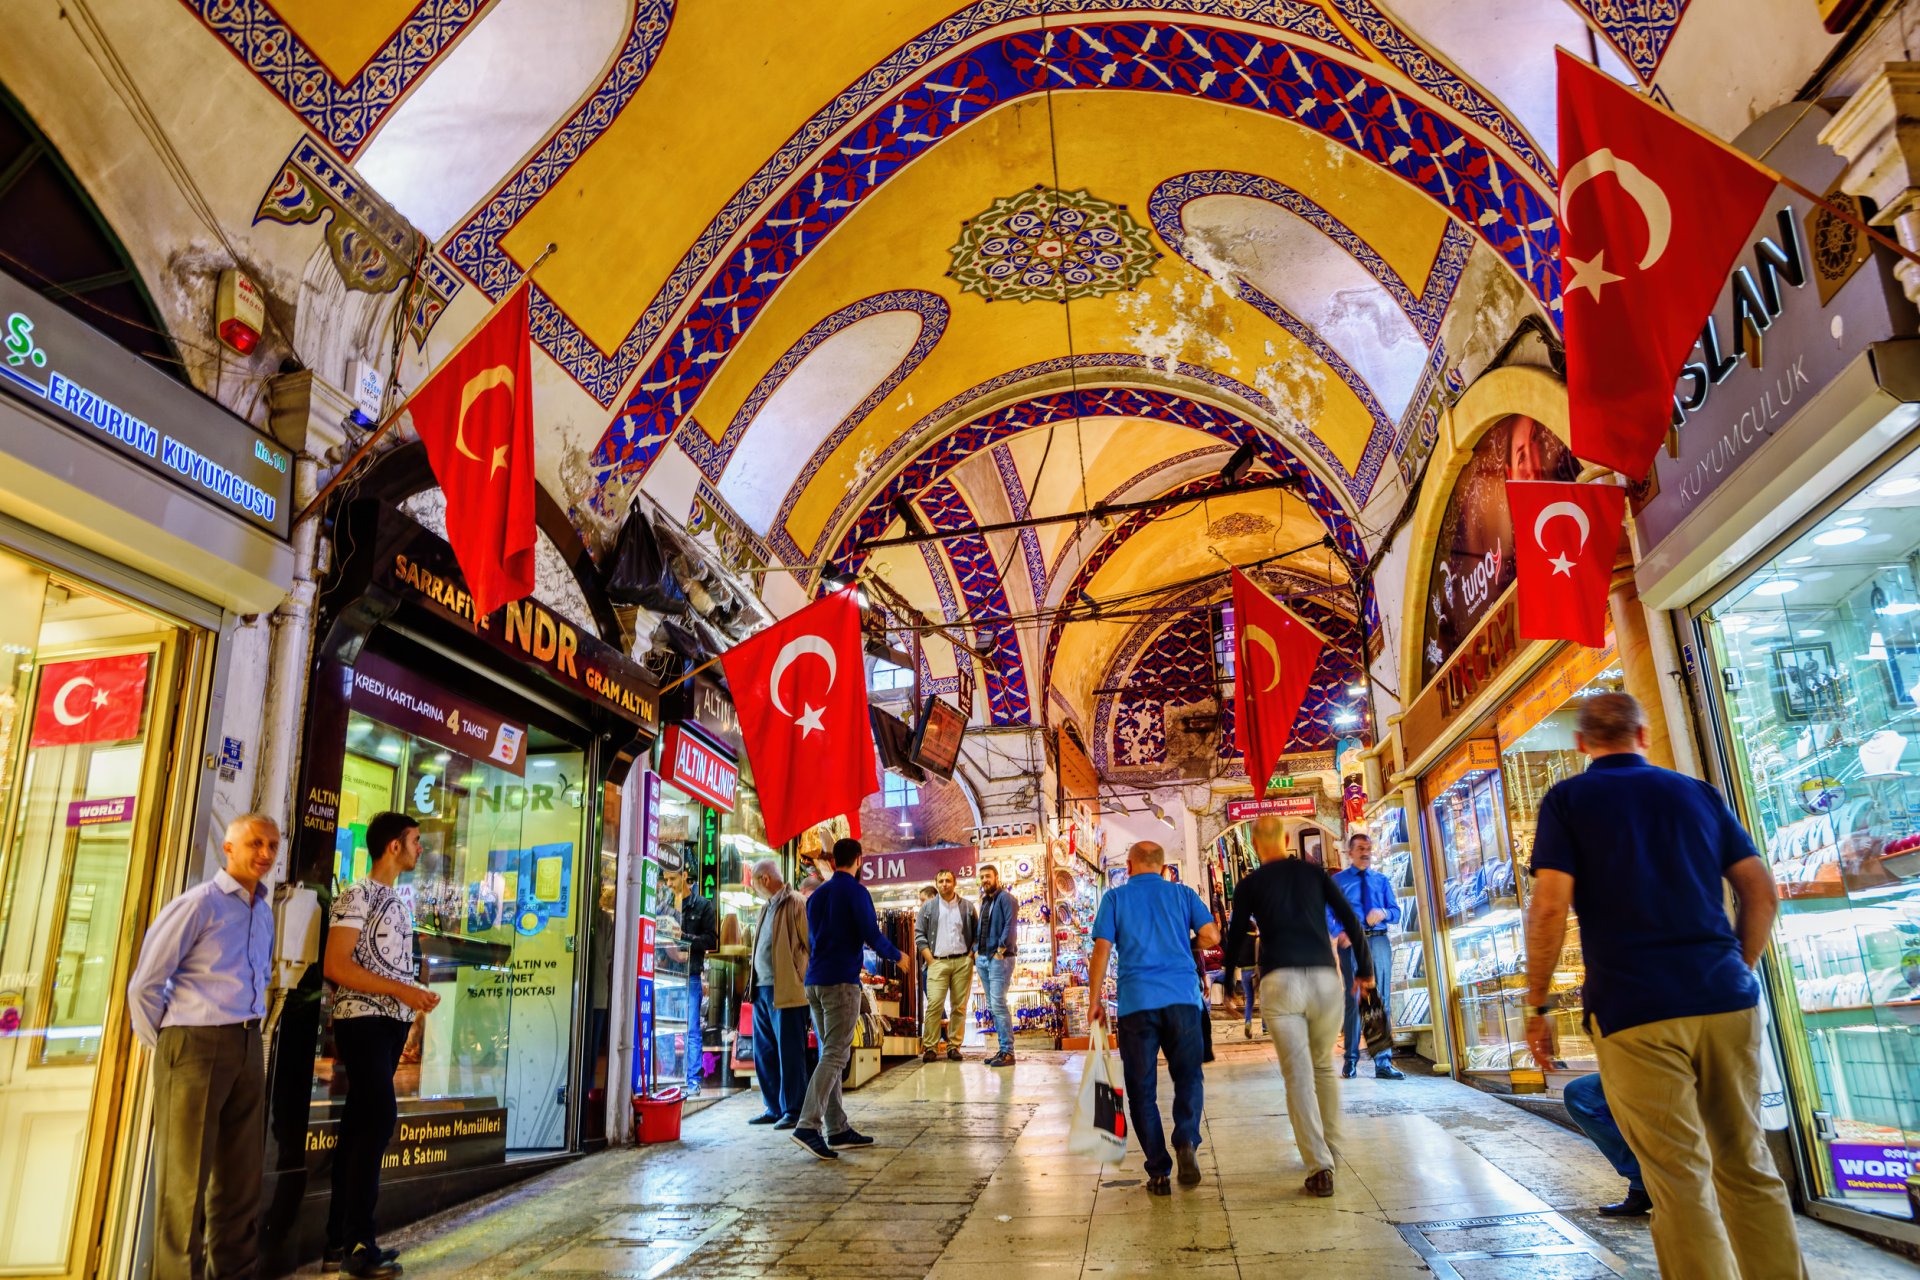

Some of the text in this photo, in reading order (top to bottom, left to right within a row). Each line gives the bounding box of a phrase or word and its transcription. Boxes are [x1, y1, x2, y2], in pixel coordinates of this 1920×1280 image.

[1653, 205, 1806, 460] SLAN
[1679, 354, 1809, 507] KUYUMCULUK
[49, 371, 276, 521] ERZURUM KUYUMCUSU
[254, 440, 287, 473] No.10
[505, 599, 578, 680] NDR
[585, 667, 620, 703] GRAM
[621, 689, 652, 722] ALTIN
[355, 672, 489, 741] KREDİ KARTLARINA 4 TAKSİT
[704, 688, 730, 725] ALTIN
[961, 694, 971, 707] WC
[677, 740, 736, 802] ALTIN ALINIR
[1270, 778, 1292, 788] XIT
[309, 787, 340, 807] ALTIN
[474, 783, 554, 814] NDR
[79, 804, 125, 818] WORLD
[308, 803, 335, 819] ALINIR
[304, 815, 335, 833] SATILIR
[704, 807, 715, 865] ALTIN
[958, 865, 973, 877] 43
[494, 972, 534, 984] ZİYNET
[506, 985, 555, 998] NOKTASI
[400, 1121, 451, 1144] Darphane
[453, 1117, 501, 1136] Mamülleri
[402, 1153, 411, 1166] &
[414, 1147, 447, 1165] Satımı
[1838, 1159, 1914, 1177] WORL
